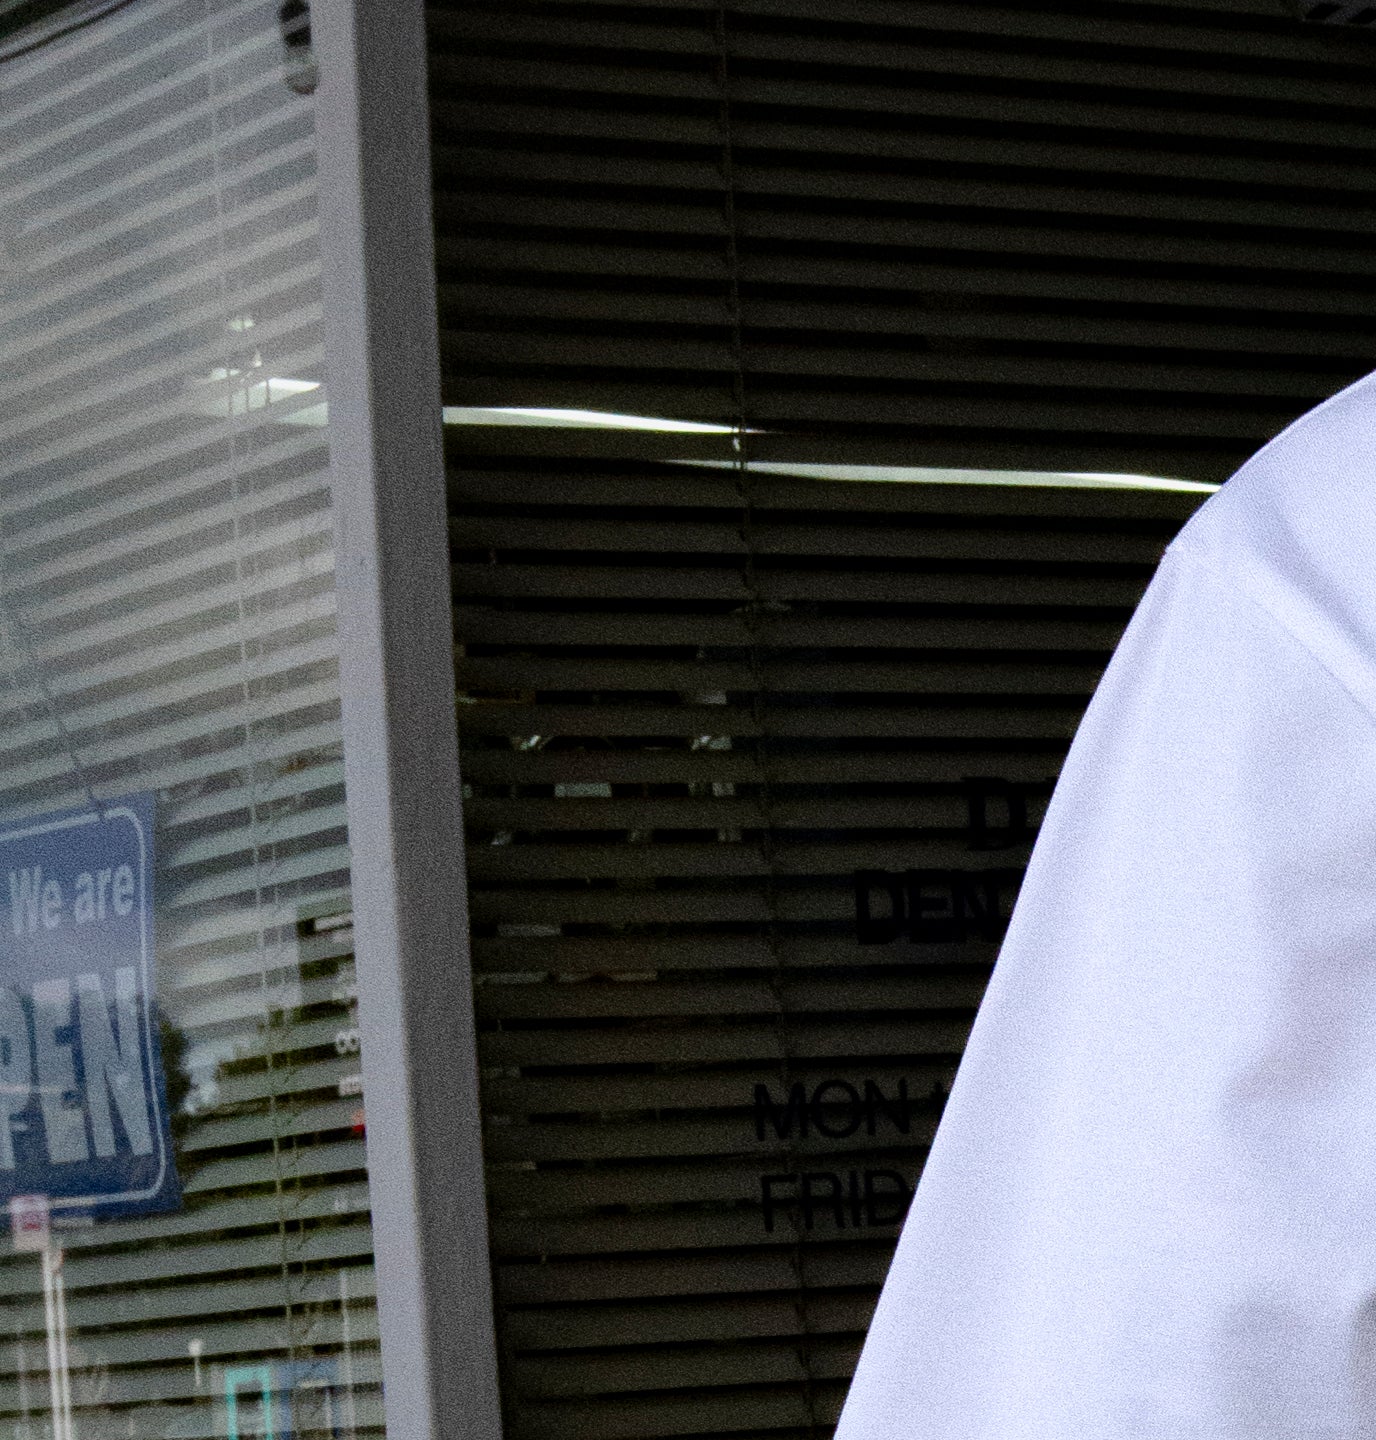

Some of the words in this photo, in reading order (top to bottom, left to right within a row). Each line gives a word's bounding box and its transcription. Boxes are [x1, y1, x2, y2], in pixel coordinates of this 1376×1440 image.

[8, 863, 62, 937] We
[74, 862, 136, 924] are
[854, 867, 1020, 943] DEN
[753, 1076, 912, 1142] MON
